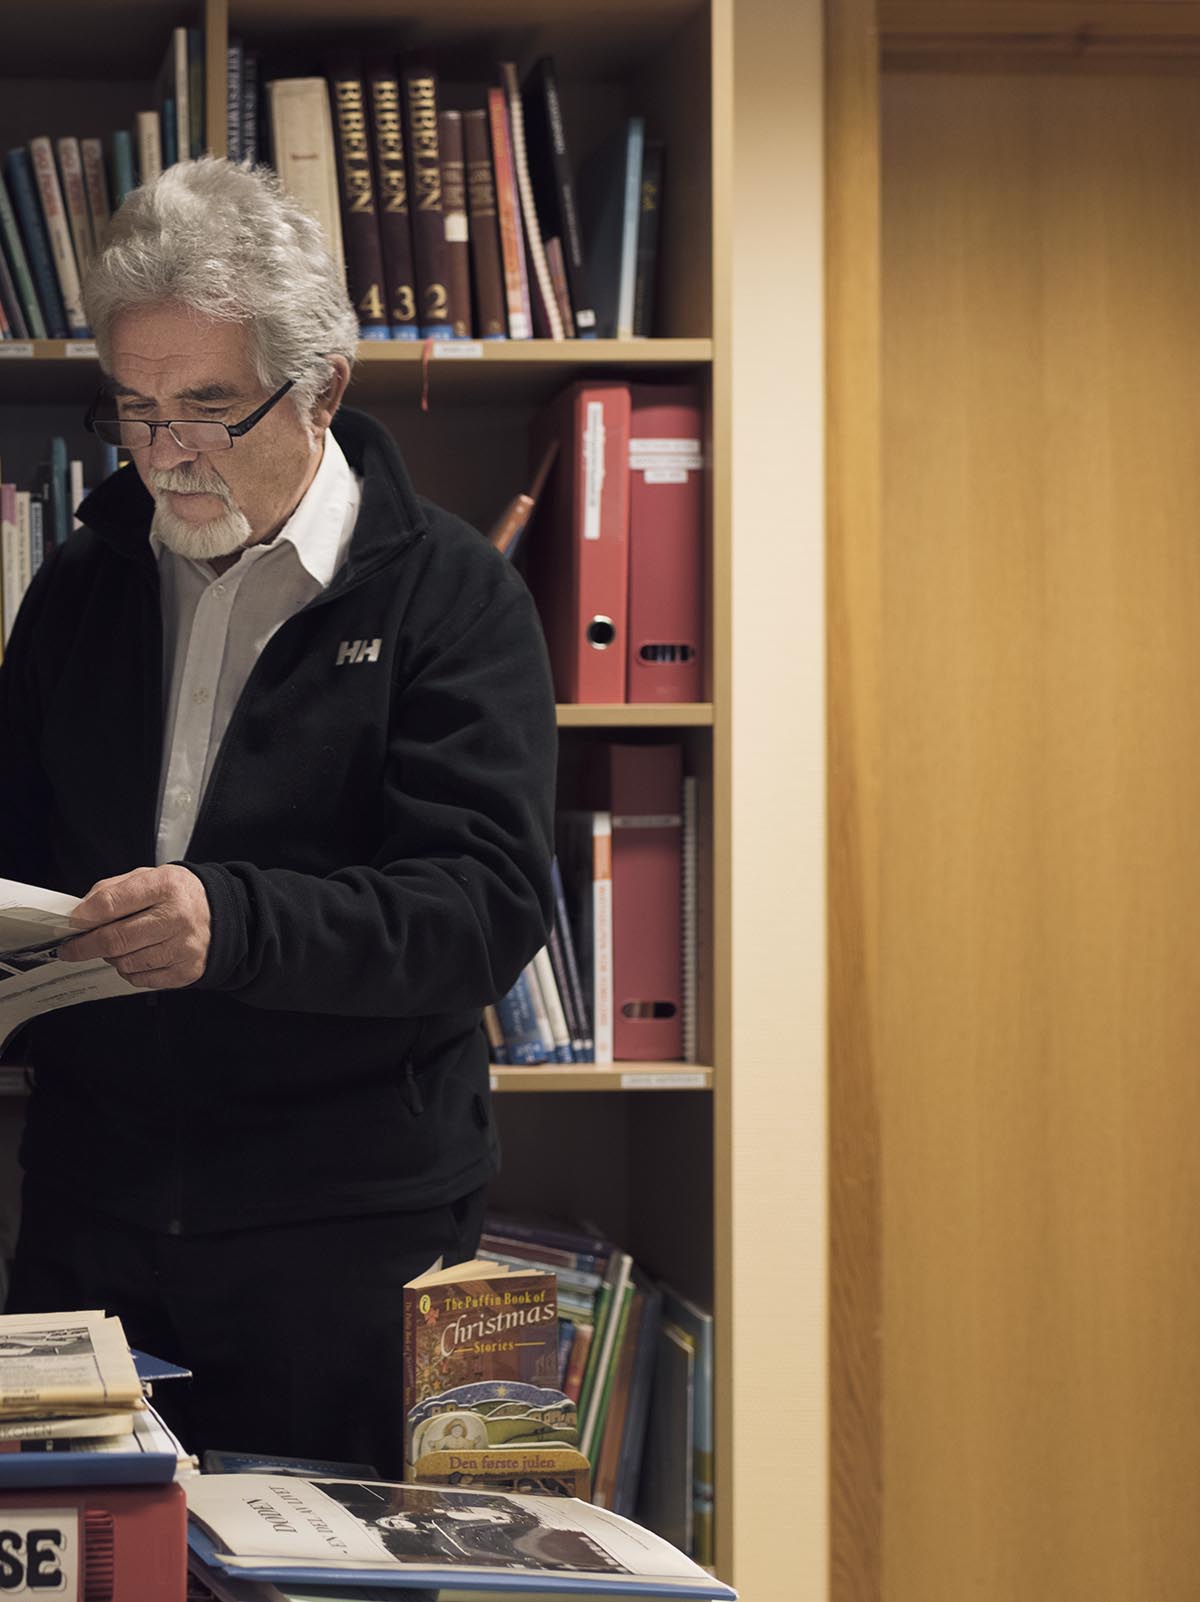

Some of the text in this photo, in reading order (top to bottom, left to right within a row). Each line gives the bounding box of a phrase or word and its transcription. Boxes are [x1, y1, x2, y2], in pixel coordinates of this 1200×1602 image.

[335, 79, 384, 320] BIBELEN 4
[372, 79, 417, 321] BIBELEN 3
[407, 77, 448, 320] BIBELEN 2
[335, 638, 382, 665] HH
[444, 1290, 546, 1311] The Puffin Book of
[440, 1303, 555, 1357] Christmas
[473, 1341, 514, 1353] Stories
[449, 1455, 556, 1471] Den første julen
[268, 1486, 303, 1505] LIVET
[306, 1518, 334, 1534] DEL
